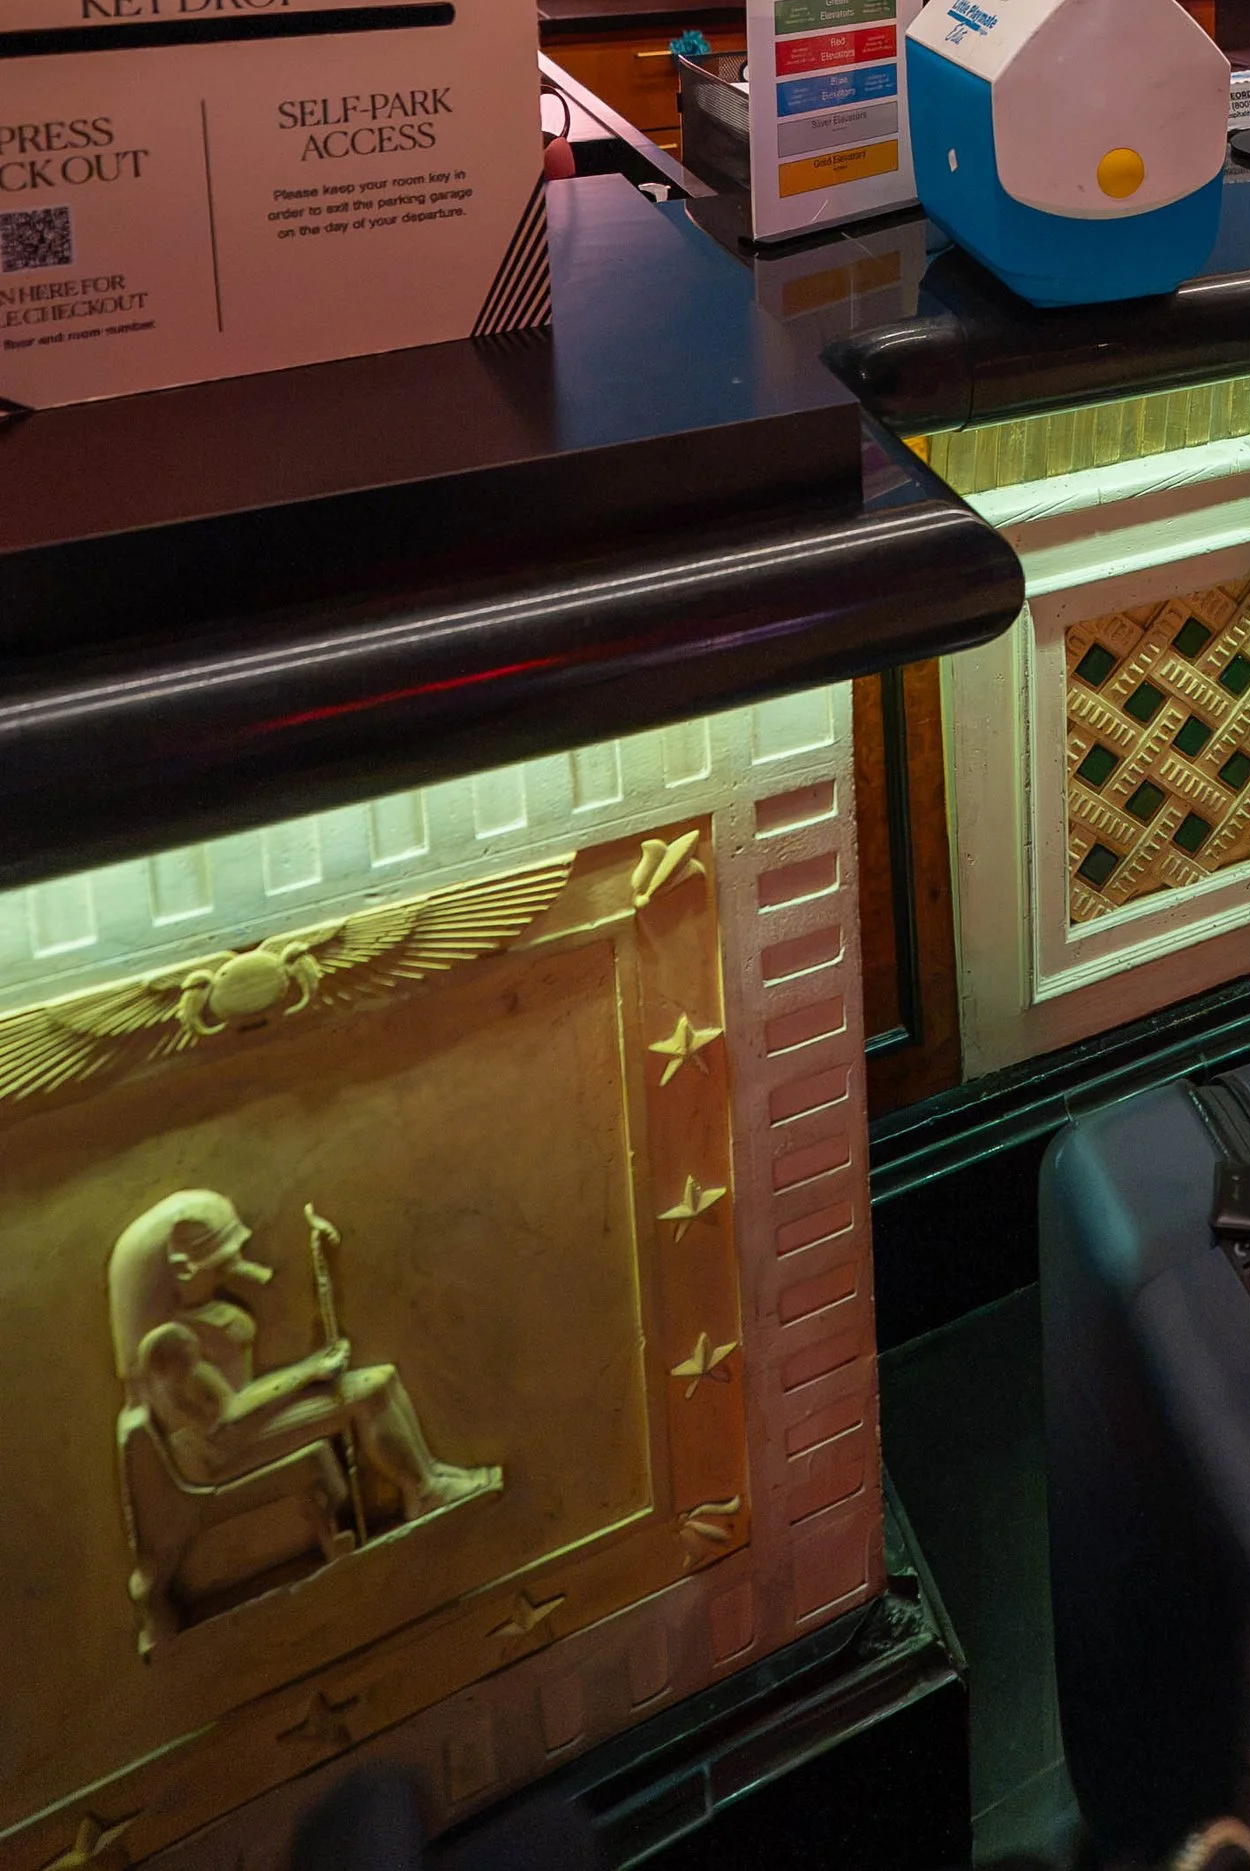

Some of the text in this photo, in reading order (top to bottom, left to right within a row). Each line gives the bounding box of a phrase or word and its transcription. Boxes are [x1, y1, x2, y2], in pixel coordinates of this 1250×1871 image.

[278, 86, 454, 130] SELF-PARK
[833, 110, 867, 125] Elevators
[300, 122, 437, 162] ACCESS
[61, 149, 150, 185] OUT
[273, 168, 467, 202] Please keep your room key in
[267, 187, 474, 222] order to exit the parking garage
[276, 207, 467, 240] on the day of your departure.
[18, 280, 79, 303] HERE
[81, 274, 126, 296] FOR
[22, 292, 149, 325] CHECKOUT
